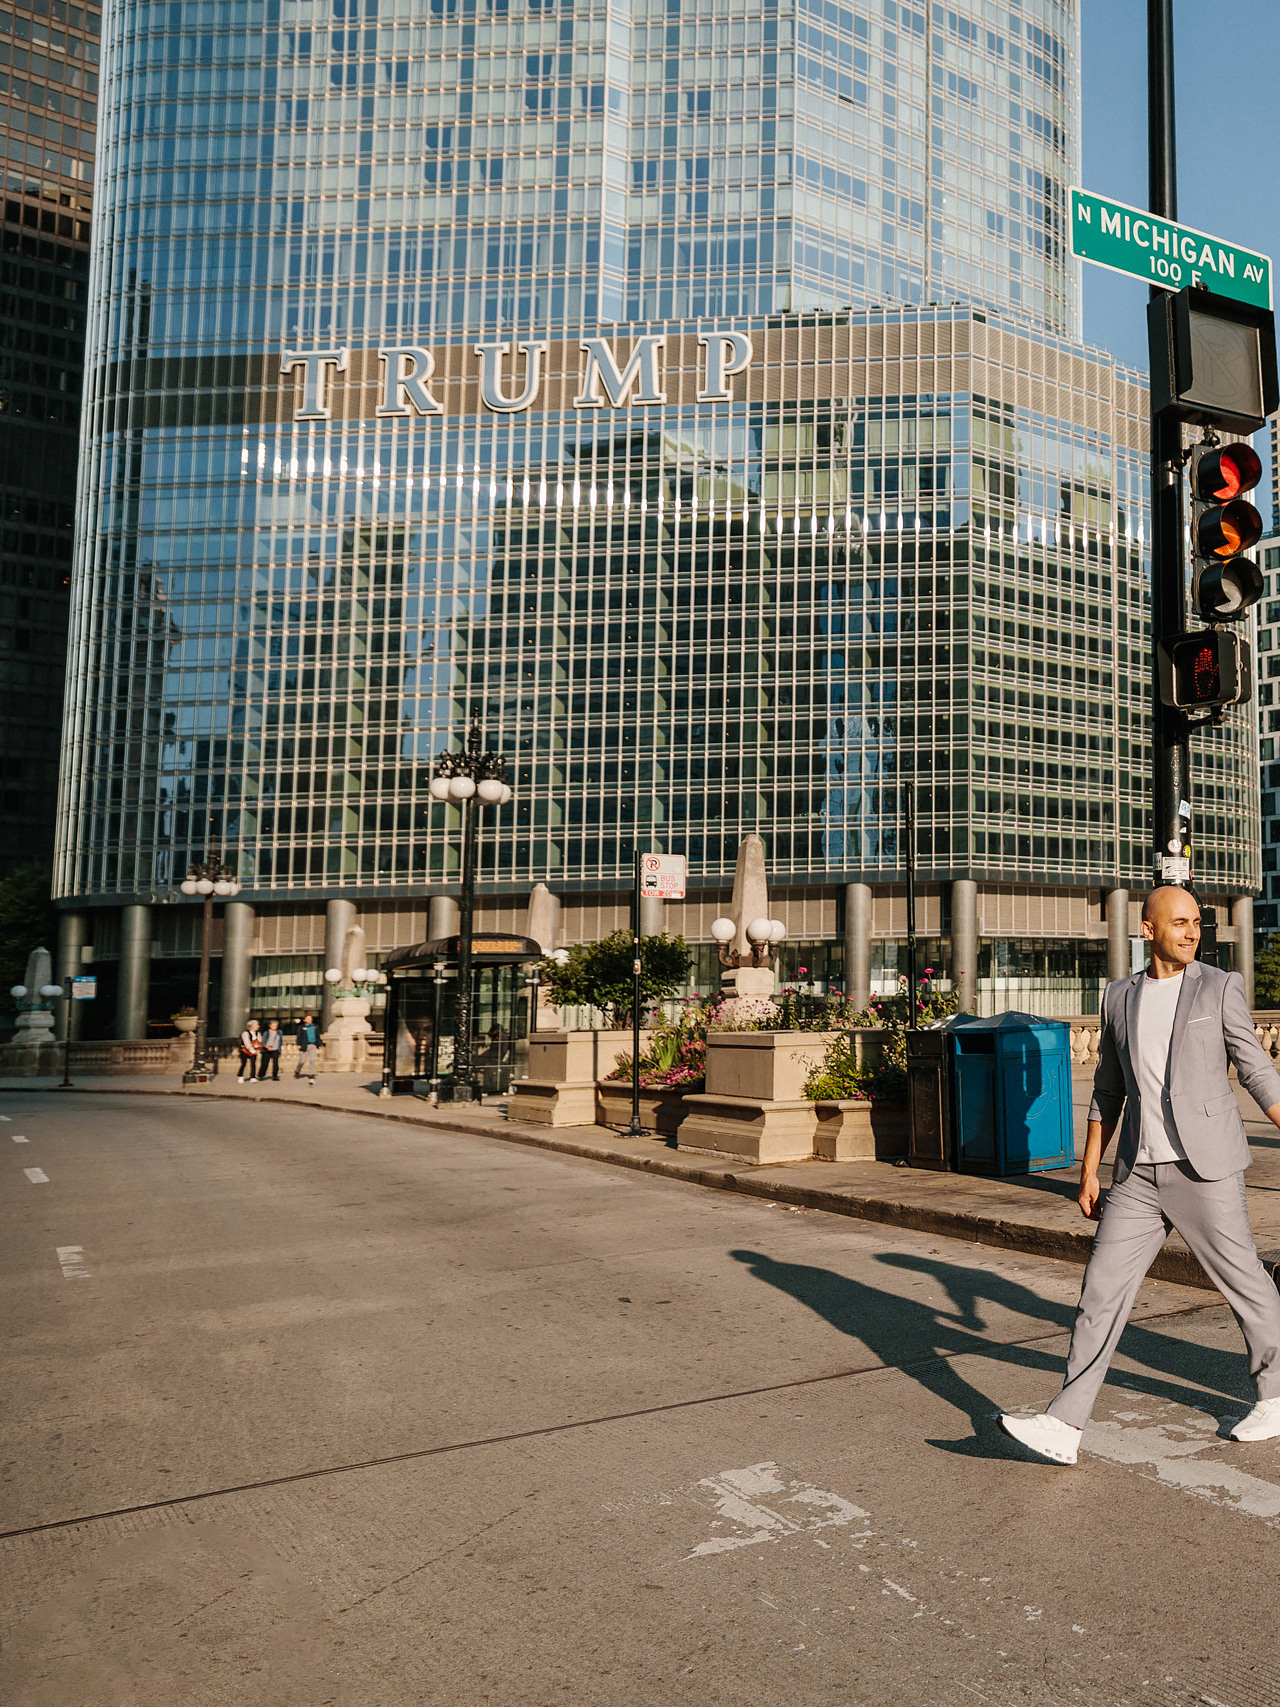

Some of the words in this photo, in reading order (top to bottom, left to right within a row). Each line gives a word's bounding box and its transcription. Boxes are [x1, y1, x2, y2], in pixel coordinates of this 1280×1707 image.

[1078, 203, 1091, 224] N
[1101, 206, 1235, 278] MICHIGAN
[1242, 263, 1264, 284] AV
[1149, 255, 1182, 282] 100
[279, 331, 754, 421] TRUMP
[660, 874, 675, 882] BUS
